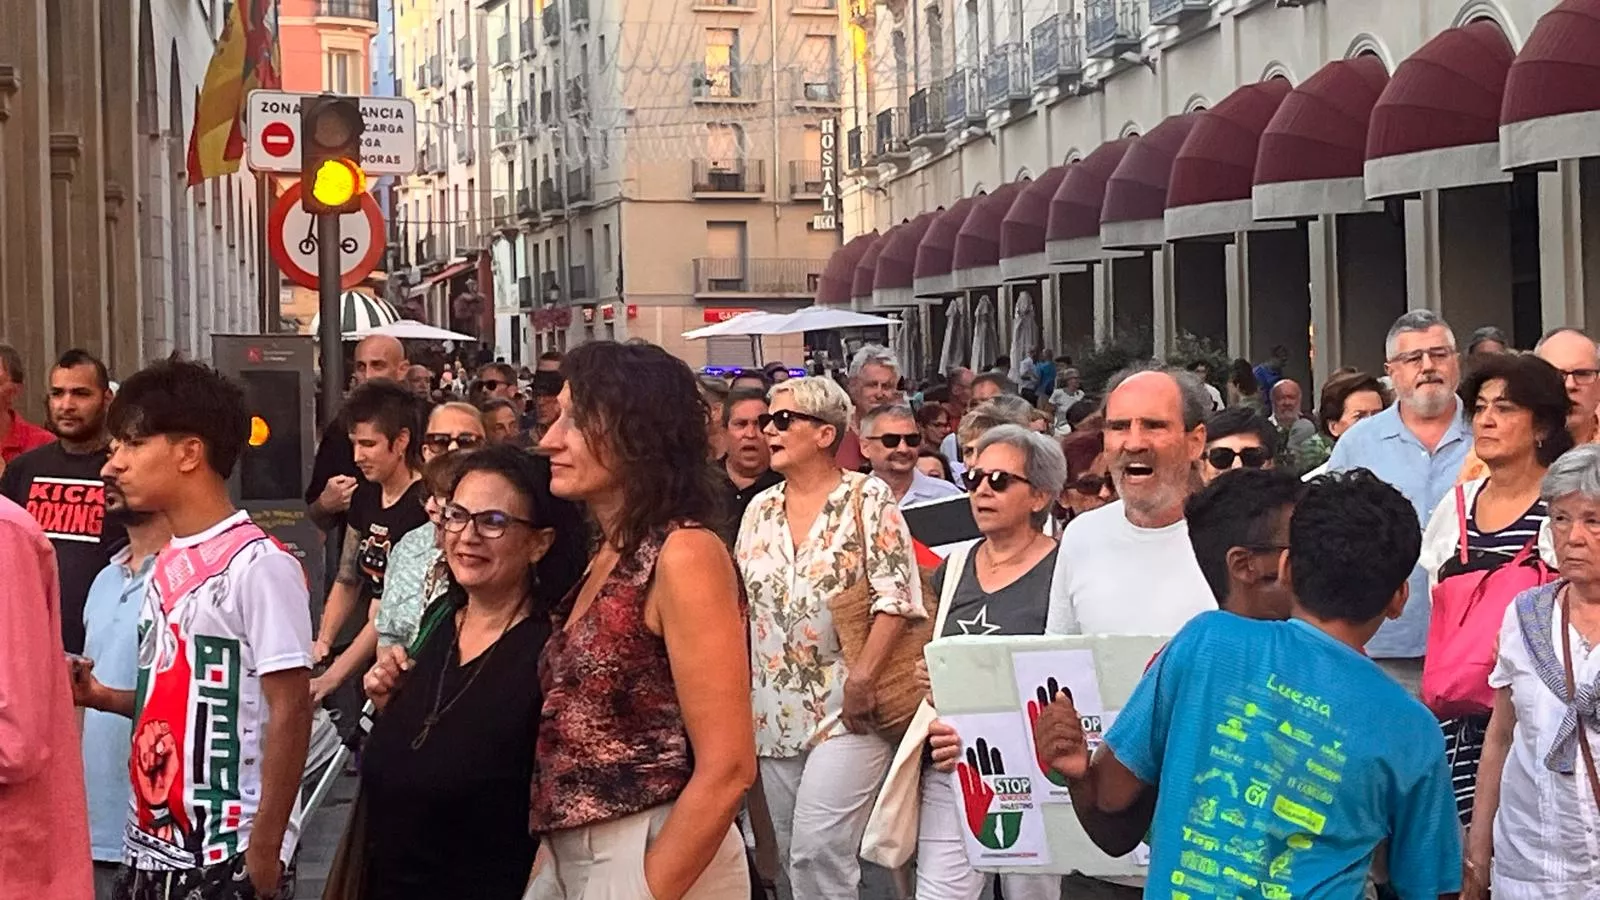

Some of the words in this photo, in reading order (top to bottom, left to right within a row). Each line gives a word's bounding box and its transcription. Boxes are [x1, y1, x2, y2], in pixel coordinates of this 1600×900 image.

[261, 102, 300, 114] ZONA
[360, 106, 404, 119] ANCIA
[364, 123, 404, 133] CARGA
[360, 154, 401, 165] HORAS
[821, 118, 835, 212] HOSTAL
[28, 483, 106, 505] KICK
[1266, 673, 1331, 718] Luesia
[1080, 716, 1101, 732] OP
[996, 778, 1031, 794] STOP
